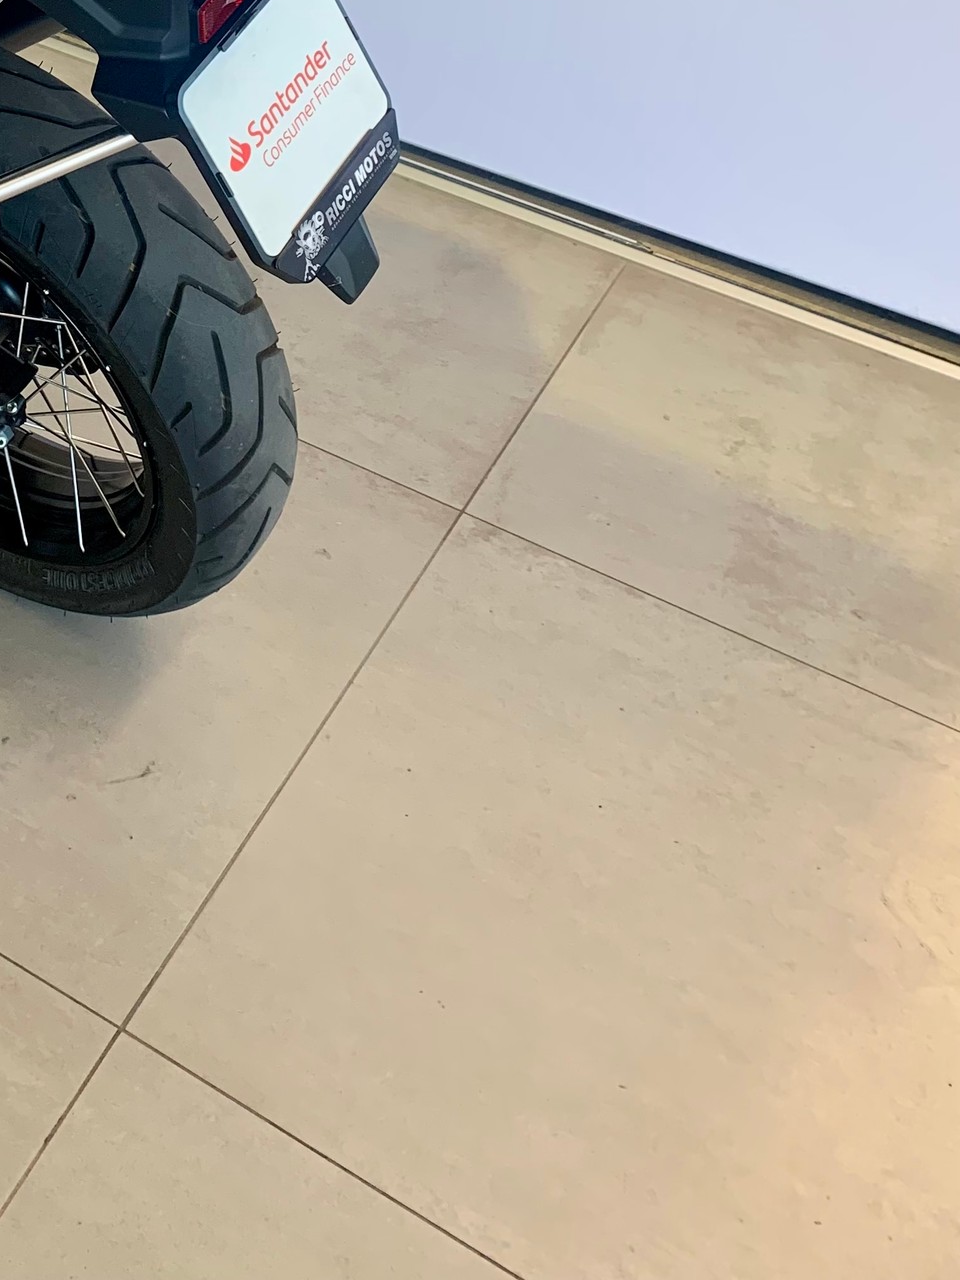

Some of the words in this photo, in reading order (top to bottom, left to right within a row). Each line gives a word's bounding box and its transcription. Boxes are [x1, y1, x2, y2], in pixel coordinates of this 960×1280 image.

[246, 40, 332, 149] Santander
[262, 97, 318, 168] Consumer
[312, 52, 357, 105] Finance
[324, 178, 357, 226] RICCI
[353, 131, 393, 187] MOTOS
